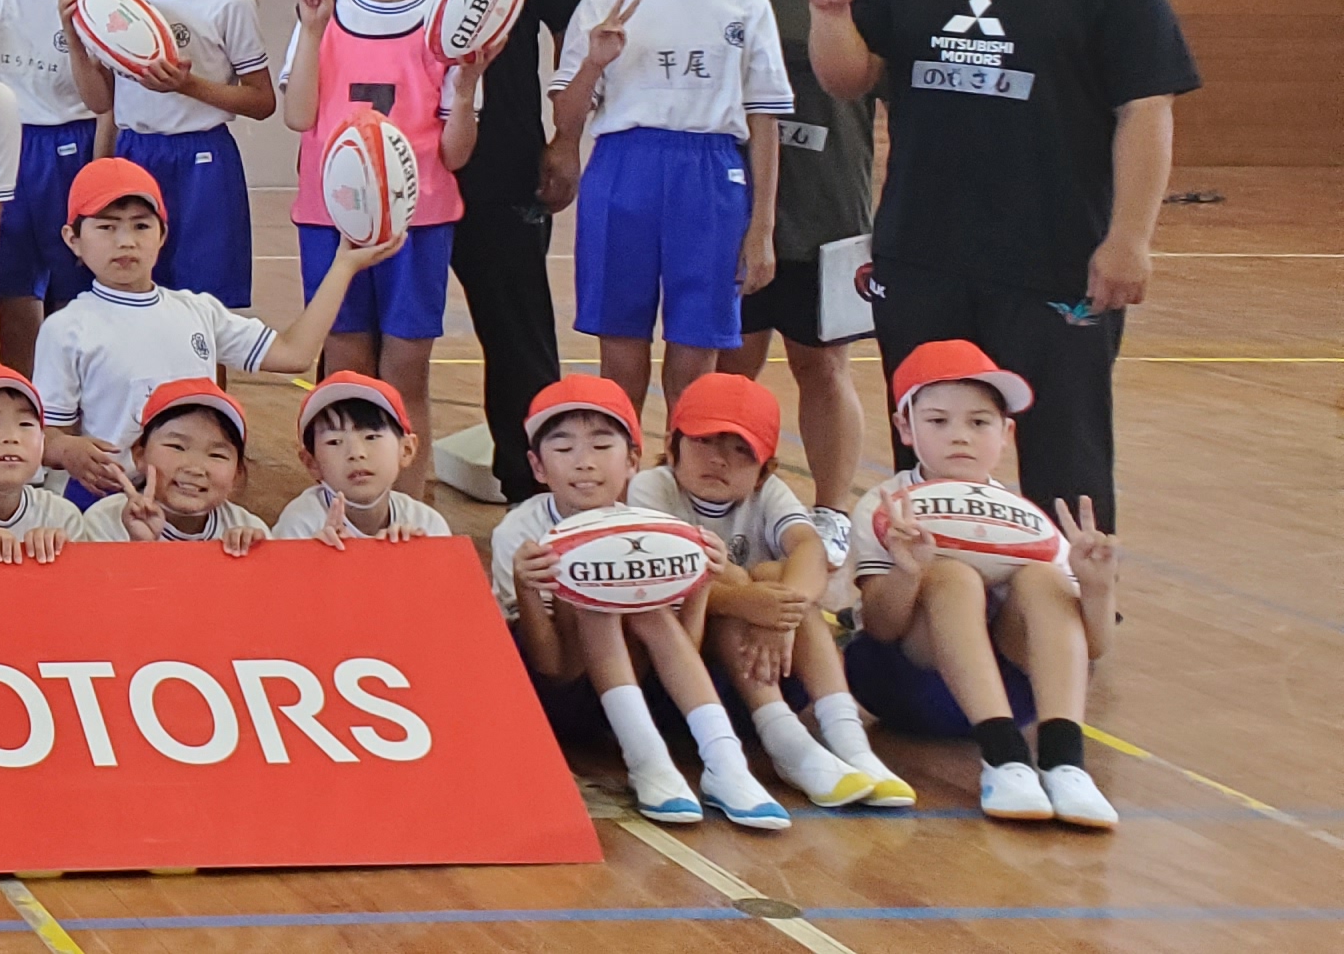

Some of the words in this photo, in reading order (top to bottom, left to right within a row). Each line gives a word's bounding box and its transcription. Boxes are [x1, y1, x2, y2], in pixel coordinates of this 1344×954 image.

[930, 36, 1015, 54] MITSUBISHI
[940, 50, 1002, 66] MOTORS
[657, 50, 711, 80] 平尾
[912, 497, 1043, 532] GILBERT
[569, 552, 700, 582] GILBERT
